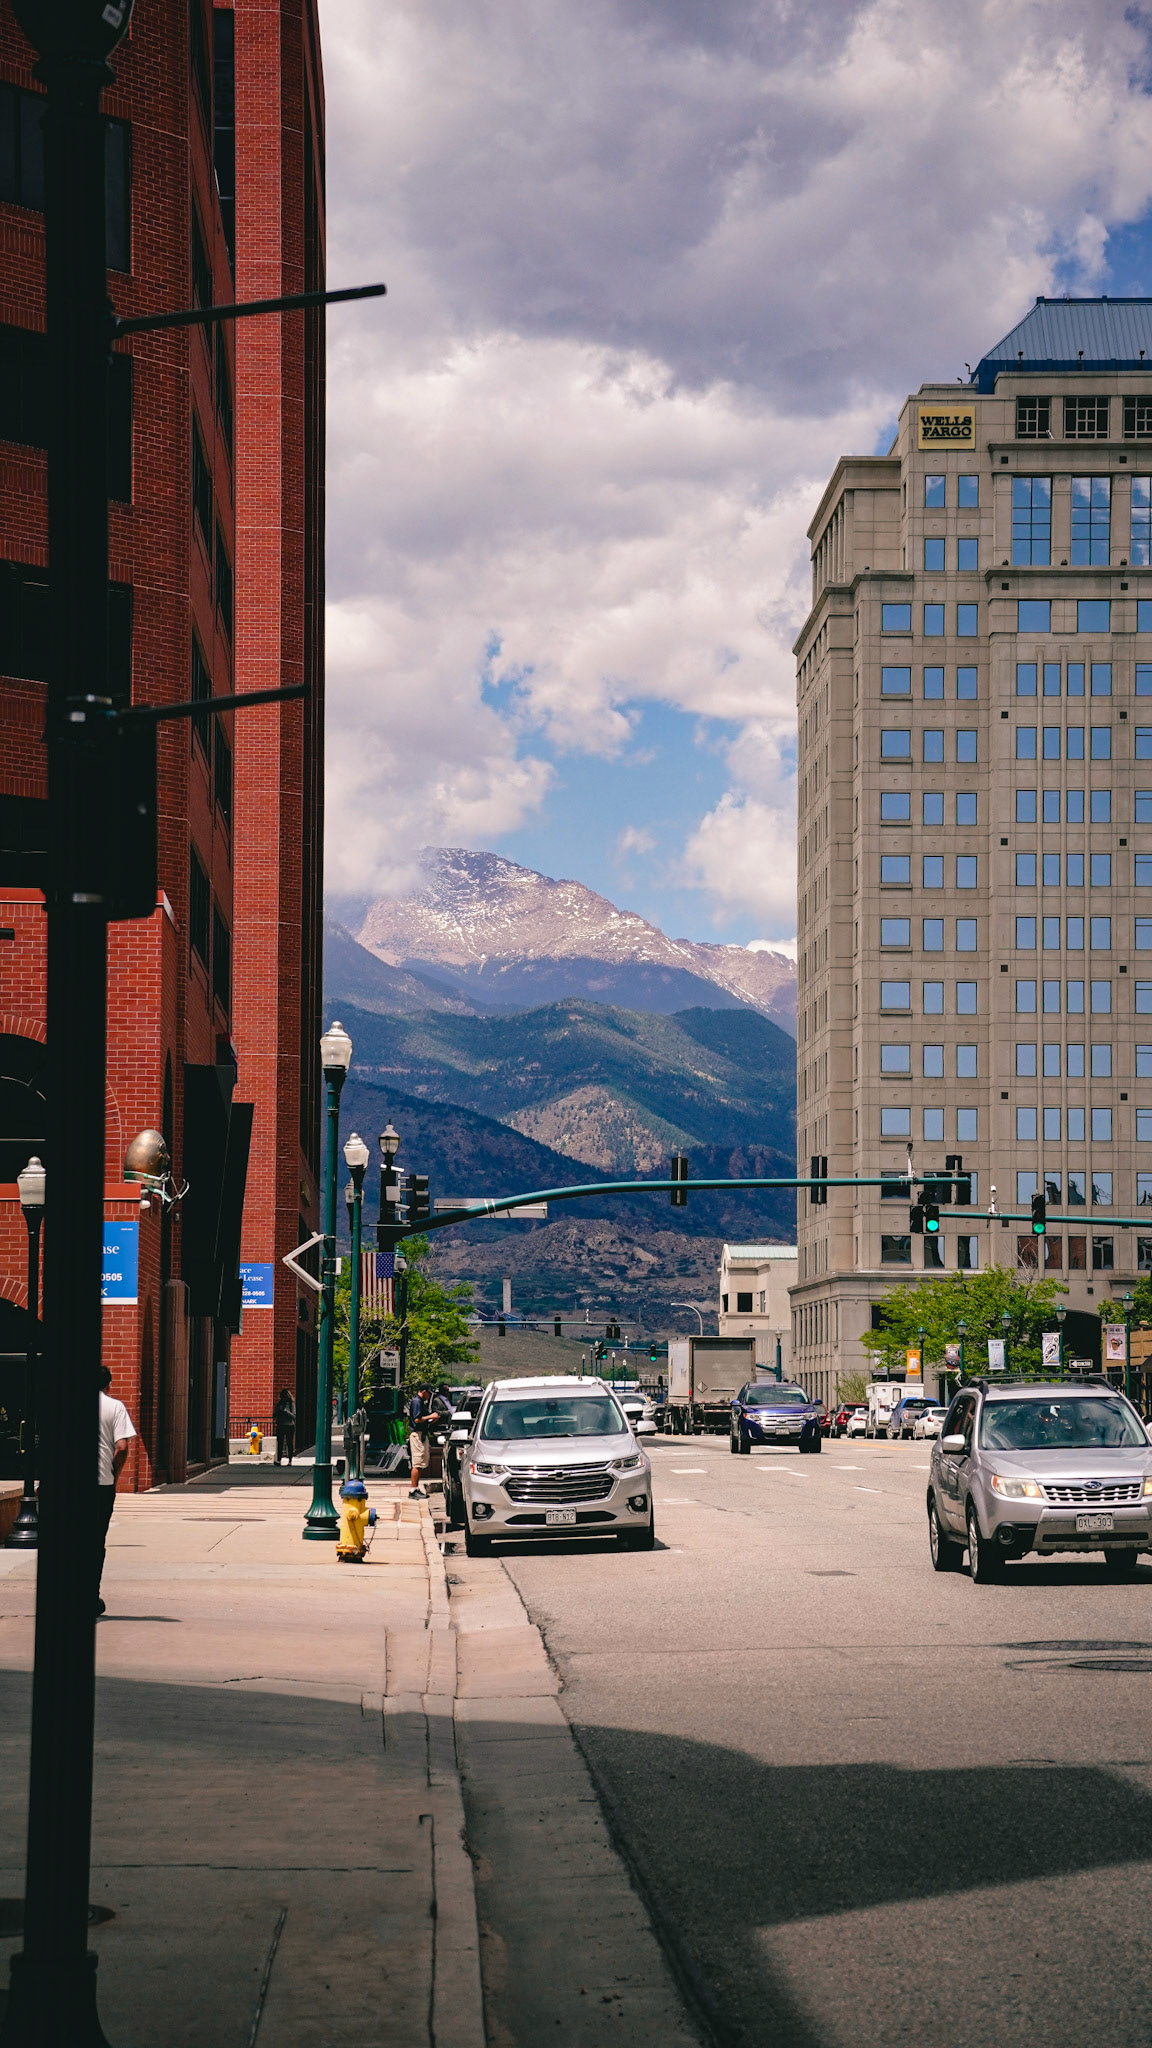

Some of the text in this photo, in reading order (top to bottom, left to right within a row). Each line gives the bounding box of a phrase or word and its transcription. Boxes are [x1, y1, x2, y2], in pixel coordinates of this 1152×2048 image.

[921, 416, 972, 426] WELLS
[922, 426, 972, 437] FARGO
[243, 1274, 264, 1282] Lease
